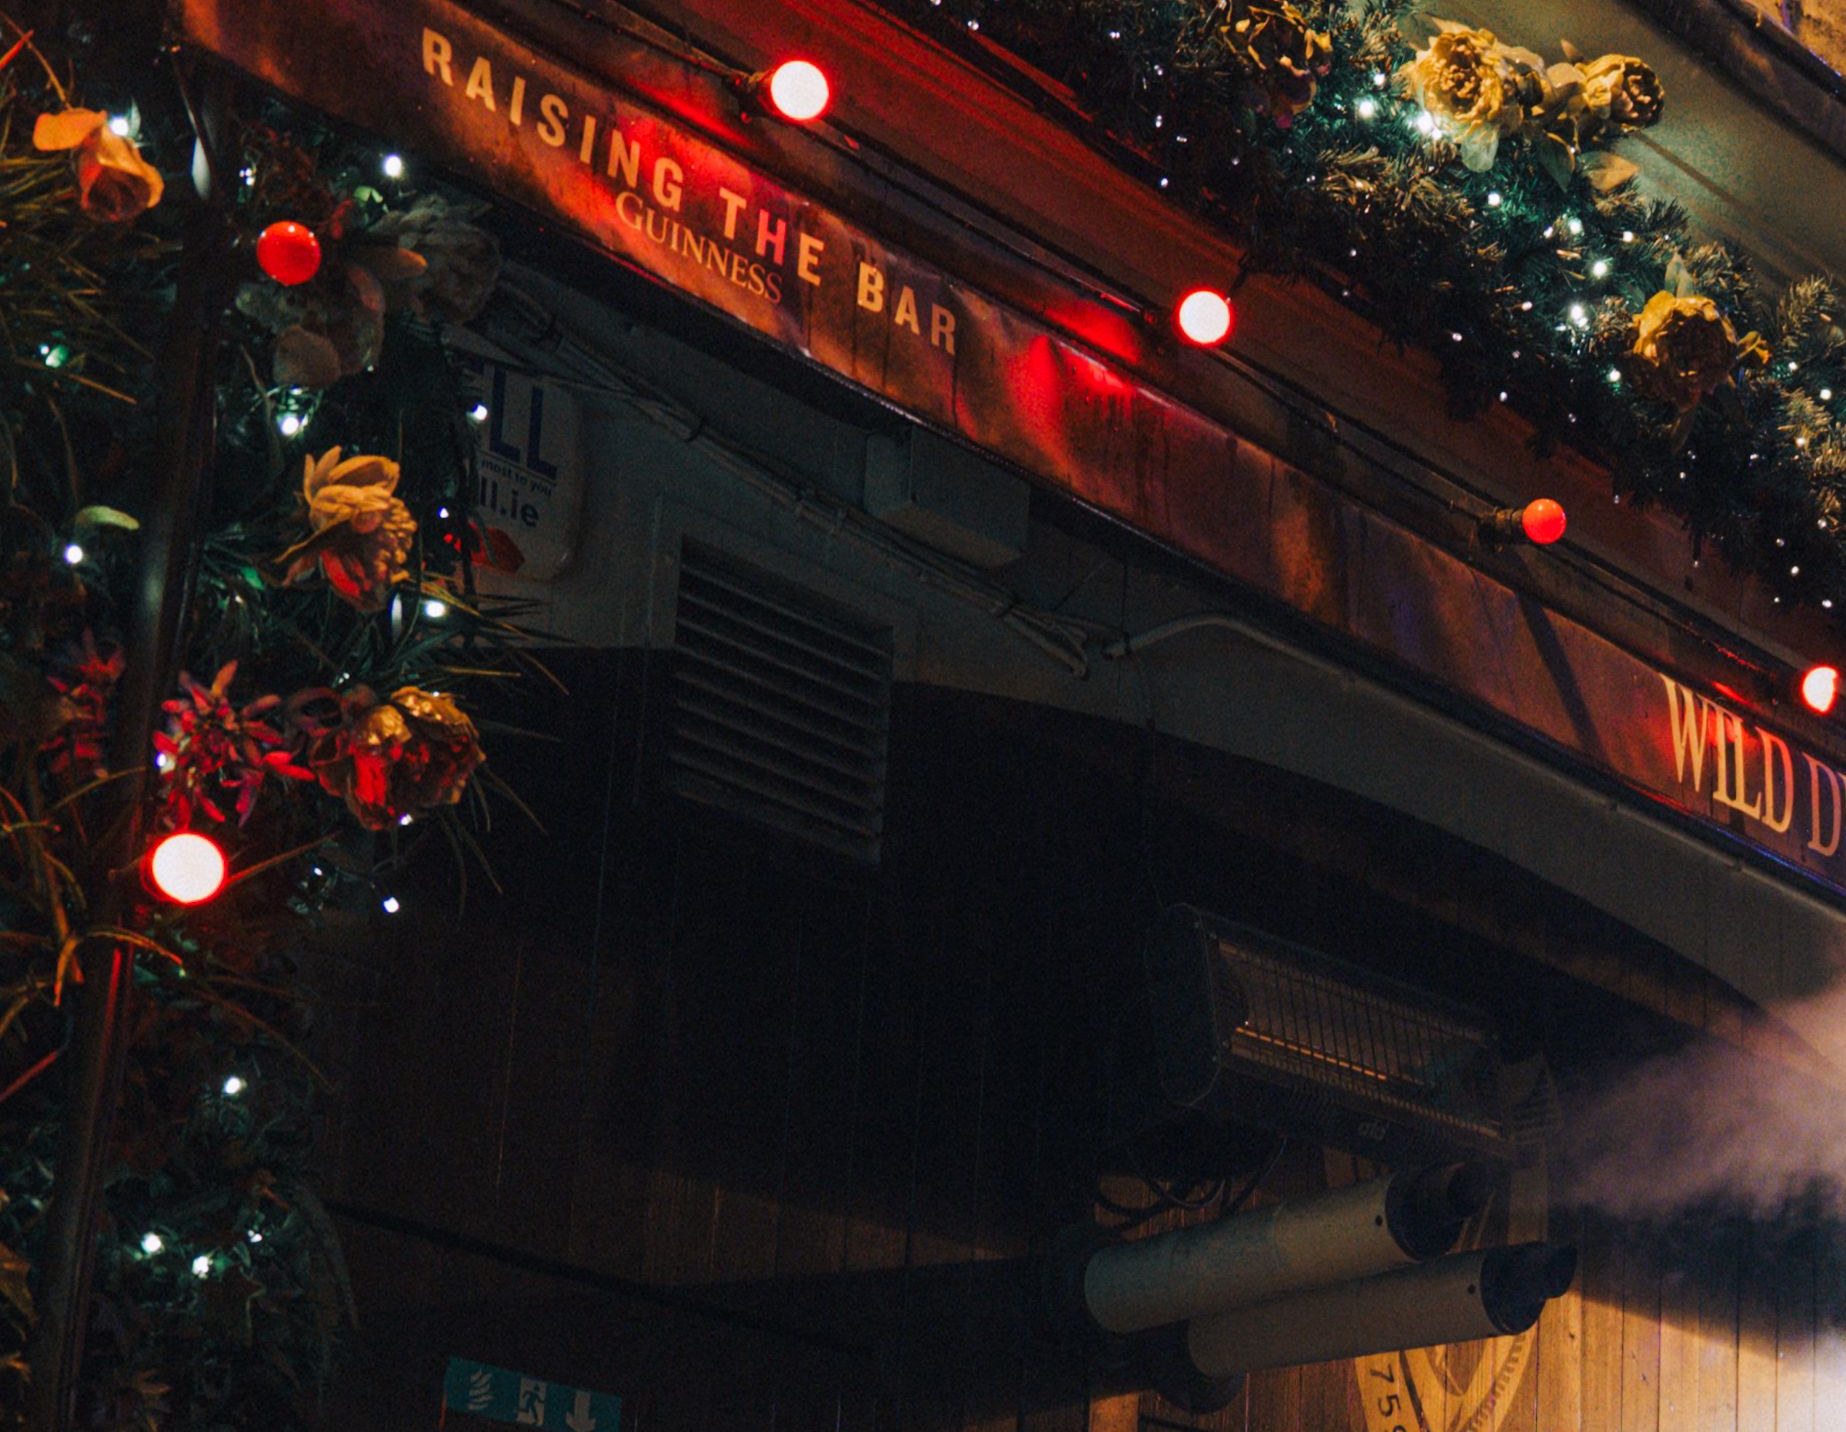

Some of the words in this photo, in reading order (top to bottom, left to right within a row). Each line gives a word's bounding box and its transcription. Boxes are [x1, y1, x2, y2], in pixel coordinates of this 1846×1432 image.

[421, 28, 685, 213] RAISING
[718, 187, 826, 287] THE
[856, 261, 958, 357] BAR
[616, 190, 783, 306] GUINNESS
[1658, 672, 1794, 835] WILD
